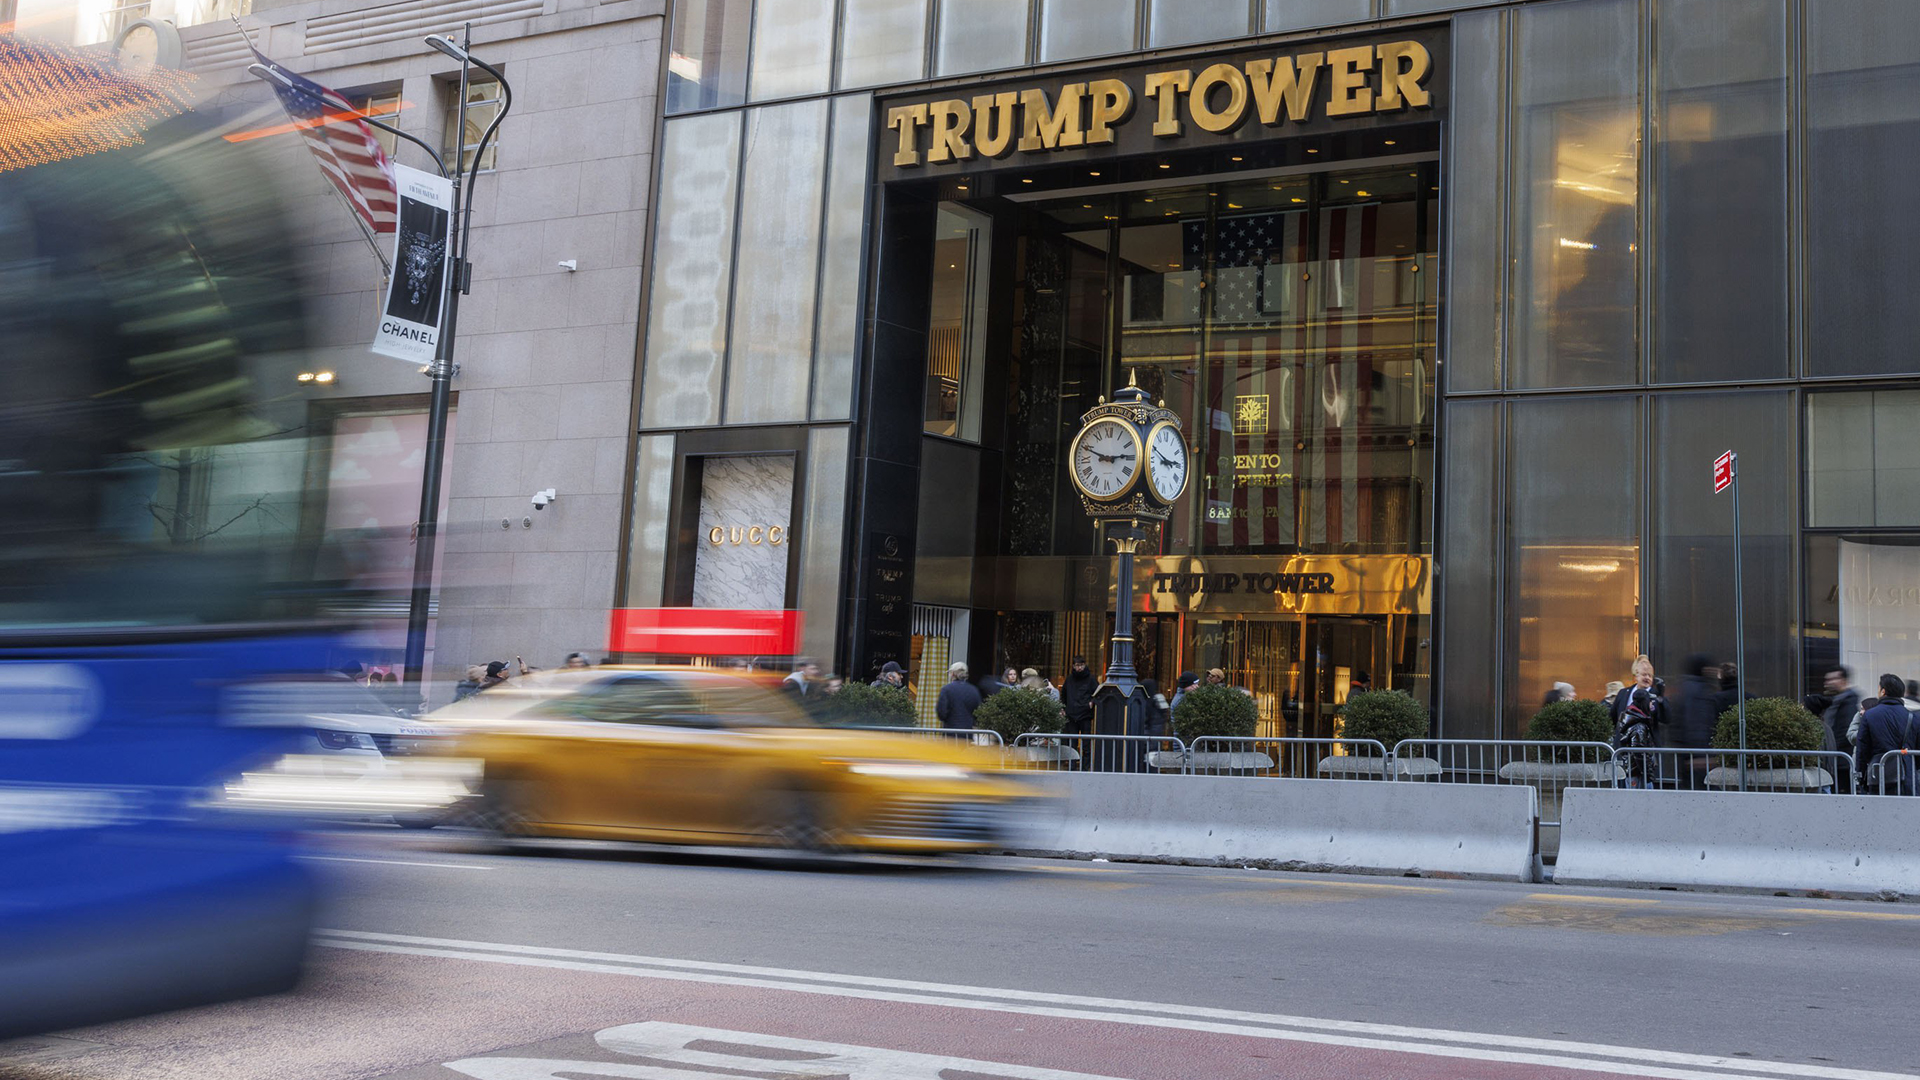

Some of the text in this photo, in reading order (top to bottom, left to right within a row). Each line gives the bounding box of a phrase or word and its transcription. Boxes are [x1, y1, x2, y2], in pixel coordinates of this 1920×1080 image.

[887, 40, 1433, 168] TRUMP TOWER
[382, 322, 435, 346] CHANEL
[1086, 406, 1132, 420] TRUMP TOWER
[1217, 454, 1281, 469] EN TO
[1208, 507, 1216, 519] 8
[1154, 572, 1335, 593] TRUMP TOWER
[875, 593, 902, 602] TRUMP
[399, 727, 436, 735] POLICE
